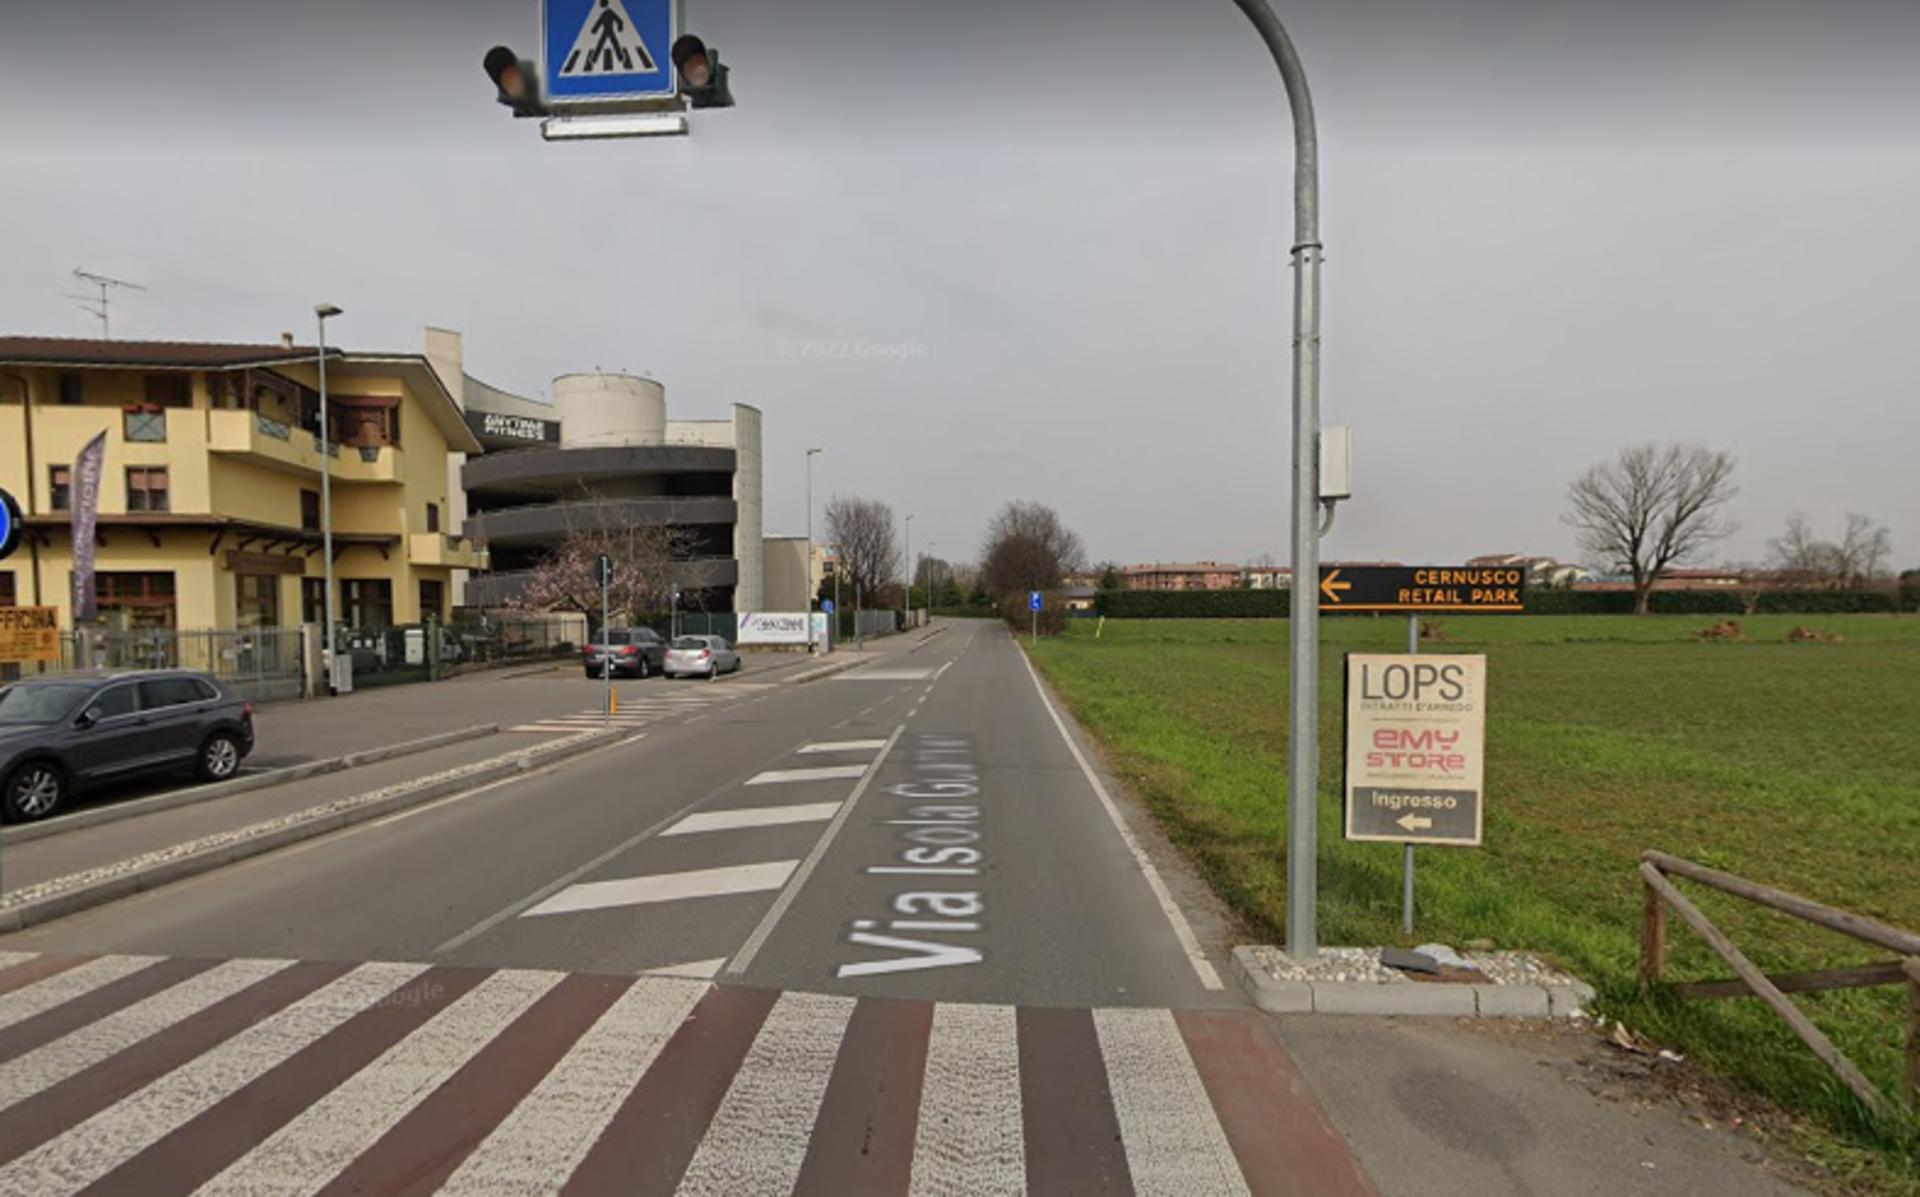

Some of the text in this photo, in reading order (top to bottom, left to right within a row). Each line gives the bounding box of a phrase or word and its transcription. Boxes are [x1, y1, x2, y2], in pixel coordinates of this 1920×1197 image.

[1414, 570, 1520, 584] CERNUSCO
[1399, 588, 1519, 603] RETAIL PARK
[1362, 664, 1464, 701] LOPS
[1372, 791, 1457, 810] Ingresso
